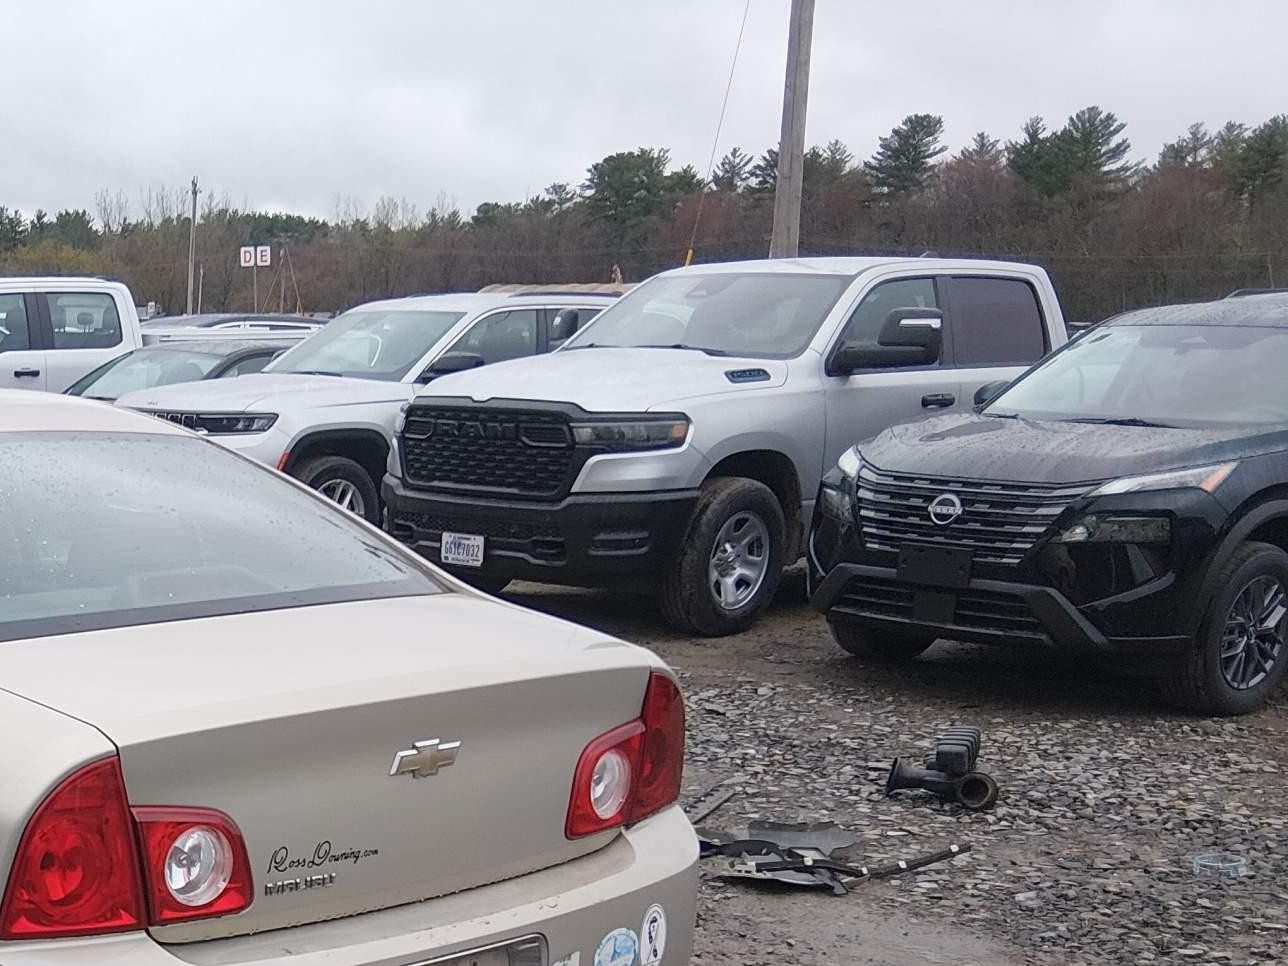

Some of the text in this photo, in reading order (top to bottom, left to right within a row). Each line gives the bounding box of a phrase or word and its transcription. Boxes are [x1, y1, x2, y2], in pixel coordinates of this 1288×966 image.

[244, 250, 252, 263] D
[261, 250, 268, 262] E
[434, 419, 519, 439] RAM
